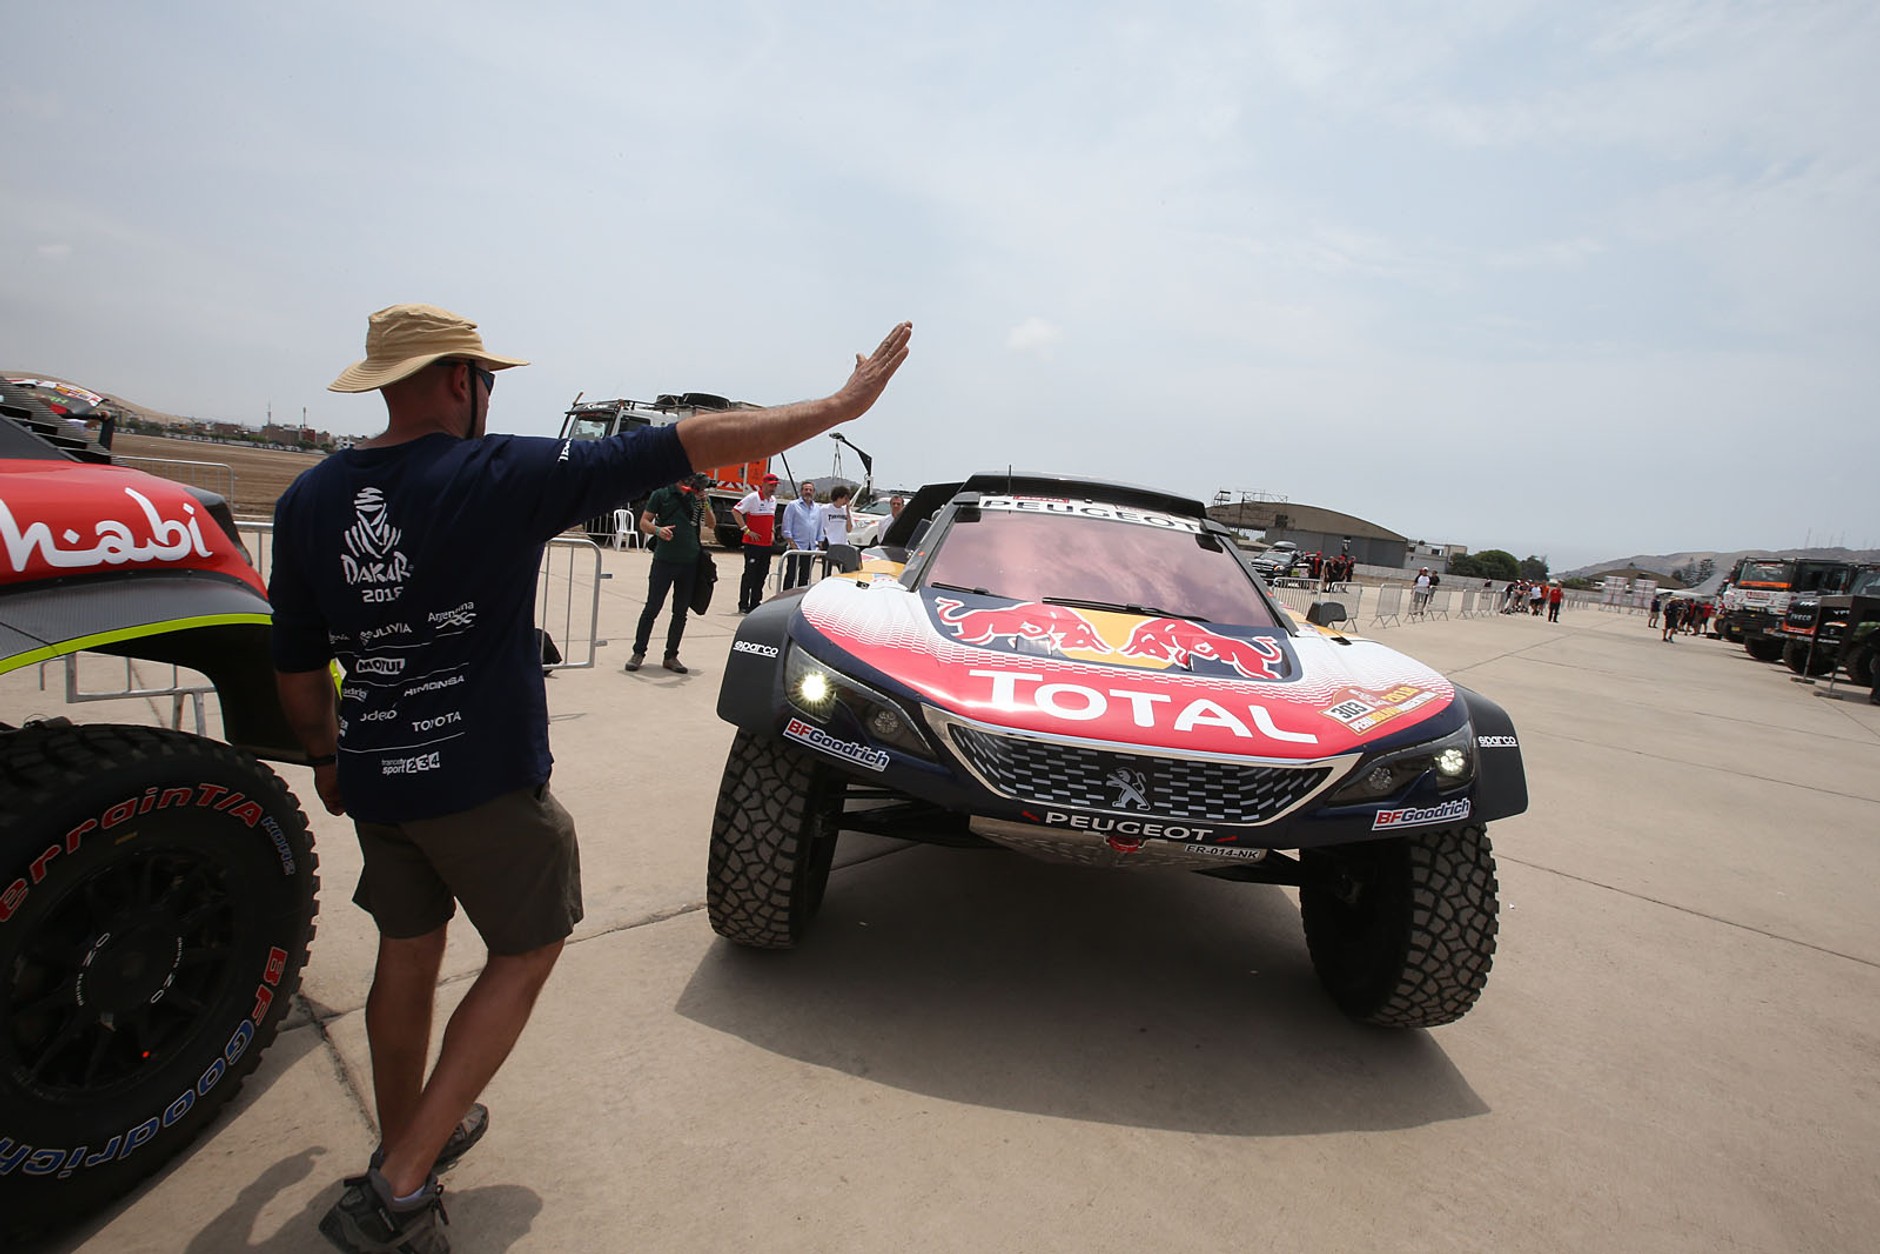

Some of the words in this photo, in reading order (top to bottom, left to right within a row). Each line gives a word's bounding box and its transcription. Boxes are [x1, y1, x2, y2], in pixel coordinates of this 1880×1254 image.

[982, 499, 1199, 532] PEUGEOT
[341, 551, 410, 585] DAKAR
[732, 641, 778, 657] sparco
[966, 669, 1319, 744] TOTAL
[1331, 701, 1368, 720] 303
[787, 719, 888, 767] BFGoodrich
[1477, 736, 1517, 748] sparco
[1044, 811, 1214, 842] PEUGEOT
[1376, 799, 1468, 825] BFGoodrich
